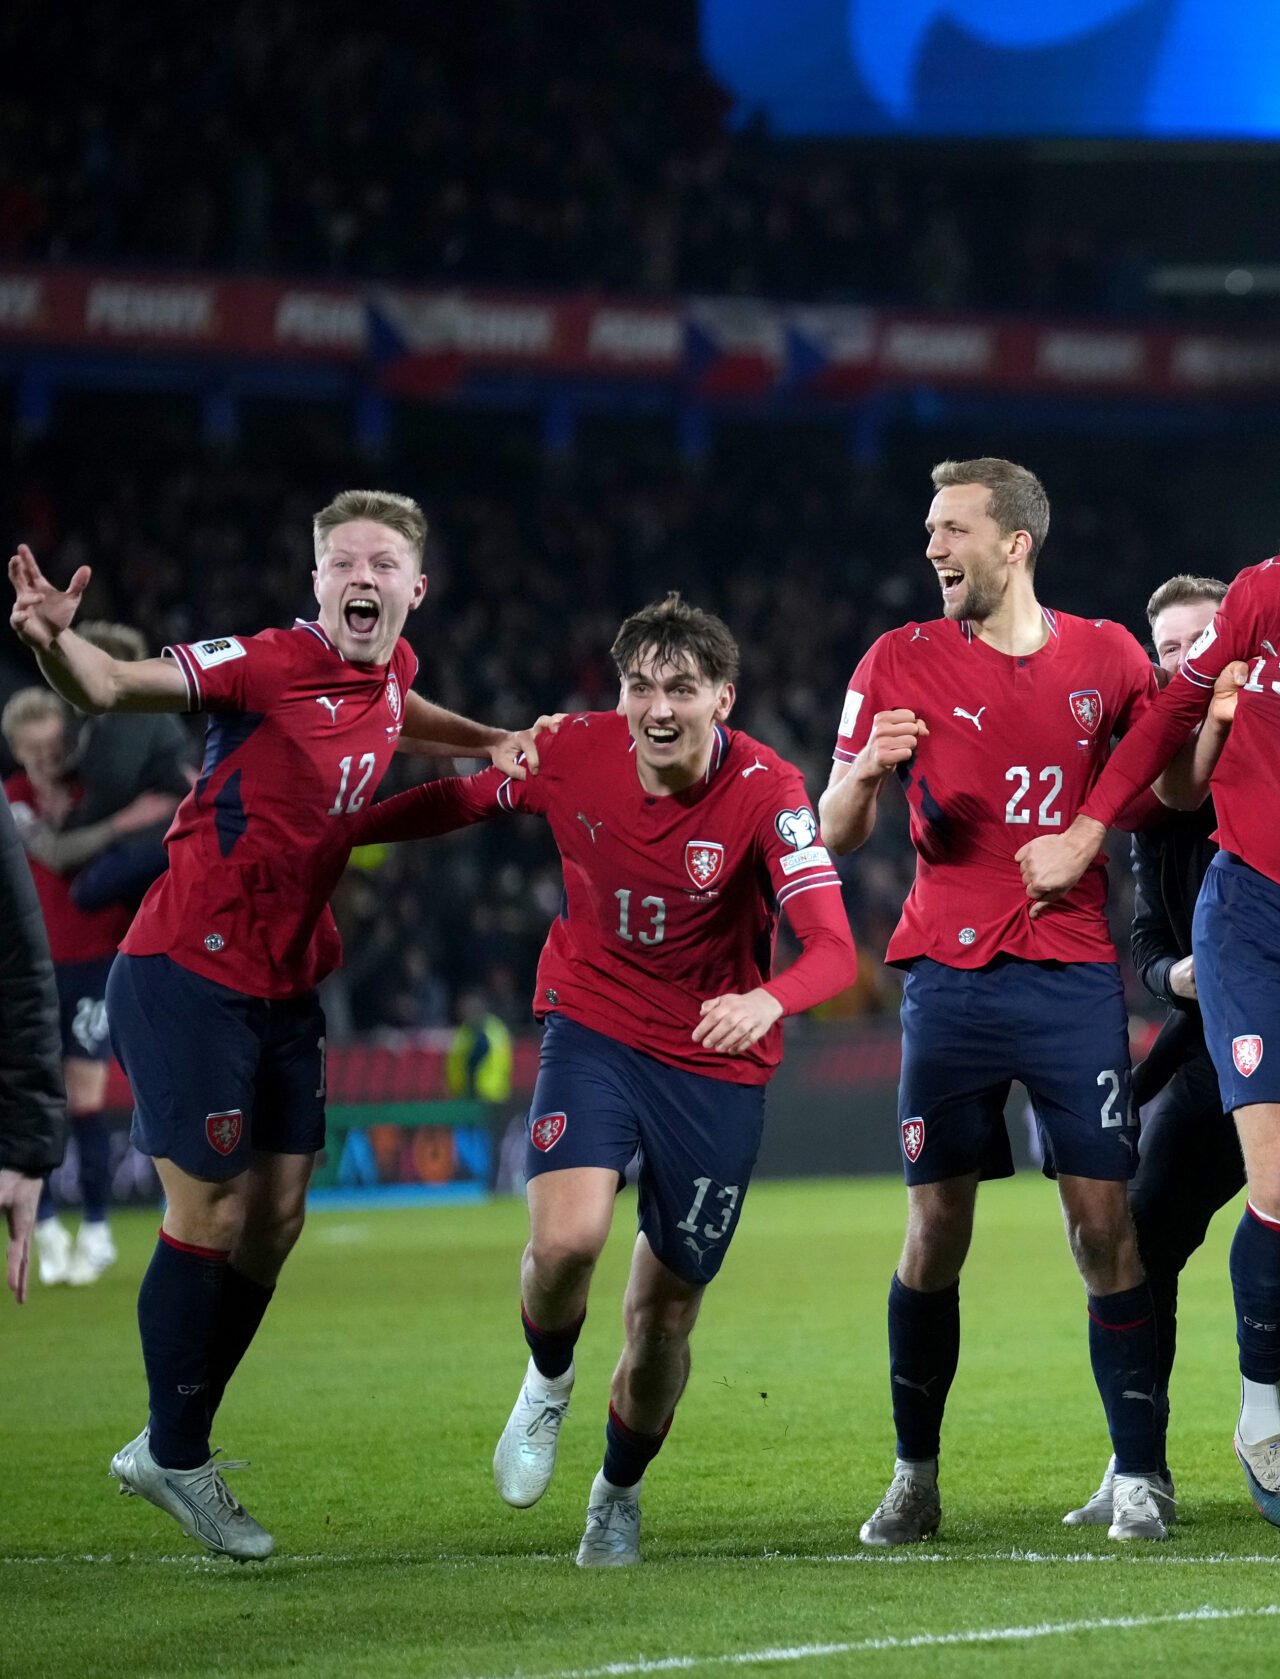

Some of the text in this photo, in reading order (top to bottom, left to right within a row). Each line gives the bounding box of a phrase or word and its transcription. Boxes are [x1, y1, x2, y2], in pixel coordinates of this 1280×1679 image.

[327, 752, 376, 816] 12
[1005, 765, 1063, 826] 22
[614, 888, 666, 945] 13
[676, 1176, 740, 1240] 13
[1243, 1315, 1278, 1333] CZE
